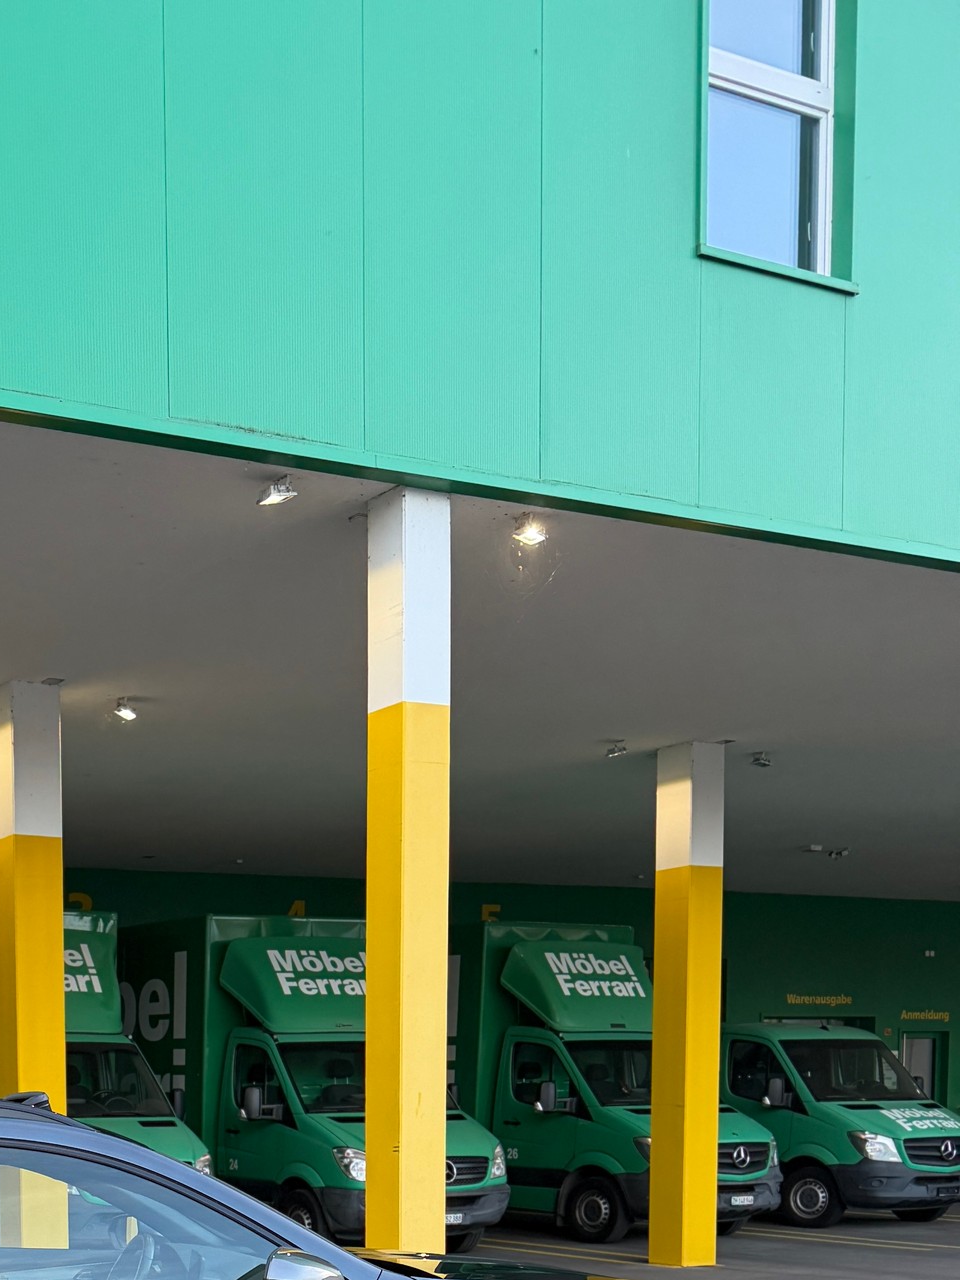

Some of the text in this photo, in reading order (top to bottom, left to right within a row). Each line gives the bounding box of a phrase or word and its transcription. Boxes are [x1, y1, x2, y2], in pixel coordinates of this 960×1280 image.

[544, 951, 636, 976] Möbel
[276, 972, 367, 996] Ferra
[555, 974, 647, 998] Ferrari
[786, 993, 853, 1007] Warenausgabe
[900, 1009, 950, 1022] Anmeldung
[880, 1107, 952, 1120] Möbel
[506, 1147, 519, 1160] 26
[229, 1157, 239, 1170] 24
